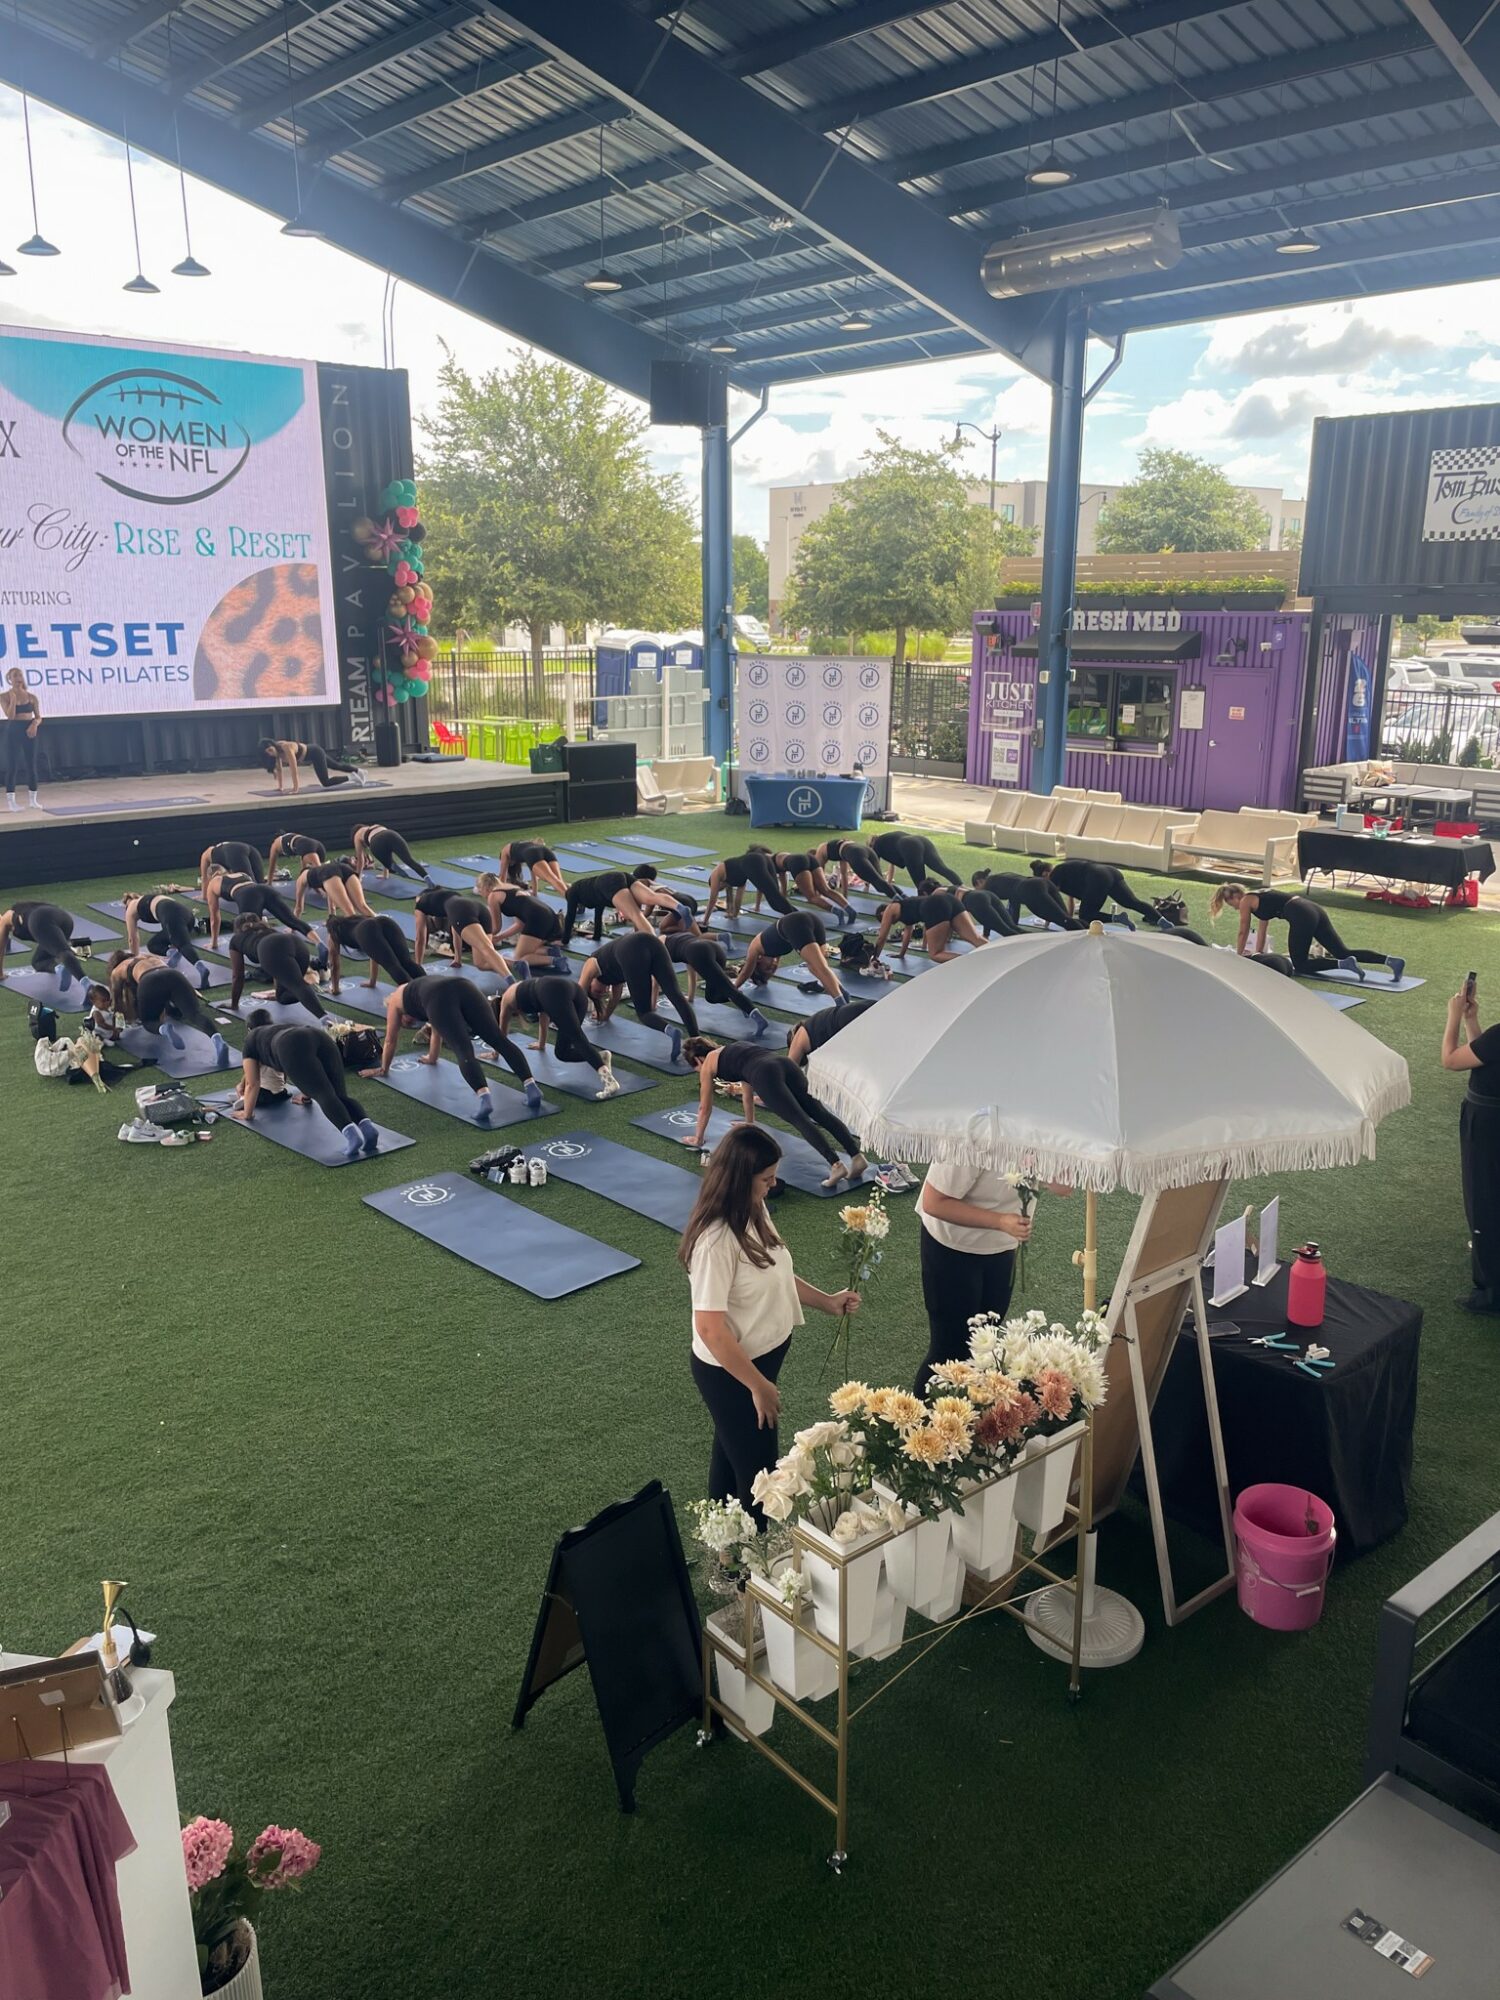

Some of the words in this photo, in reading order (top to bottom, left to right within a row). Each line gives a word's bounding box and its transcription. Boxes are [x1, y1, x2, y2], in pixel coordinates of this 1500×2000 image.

[94, 414, 228, 449] WOMEN
[115, 443, 137, 458] OF
[139, 445, 164, 460] THE
[169, 447, 219, 475] NFL
[331, 384, 365, 638] PAVILION
[195, 527, 217, 557] &
[1072, 610, 1129, 631] RESH
[1132, 610, 1181, 632] MED
[0, 667, 93, 688] DERN
[101, 665, 190, 685] PILATES
[986, 681, 1034, 702] JUST
[346, 656, 371, 743] RTEAM
[986, 700, 1033, 710] KITCHEN
